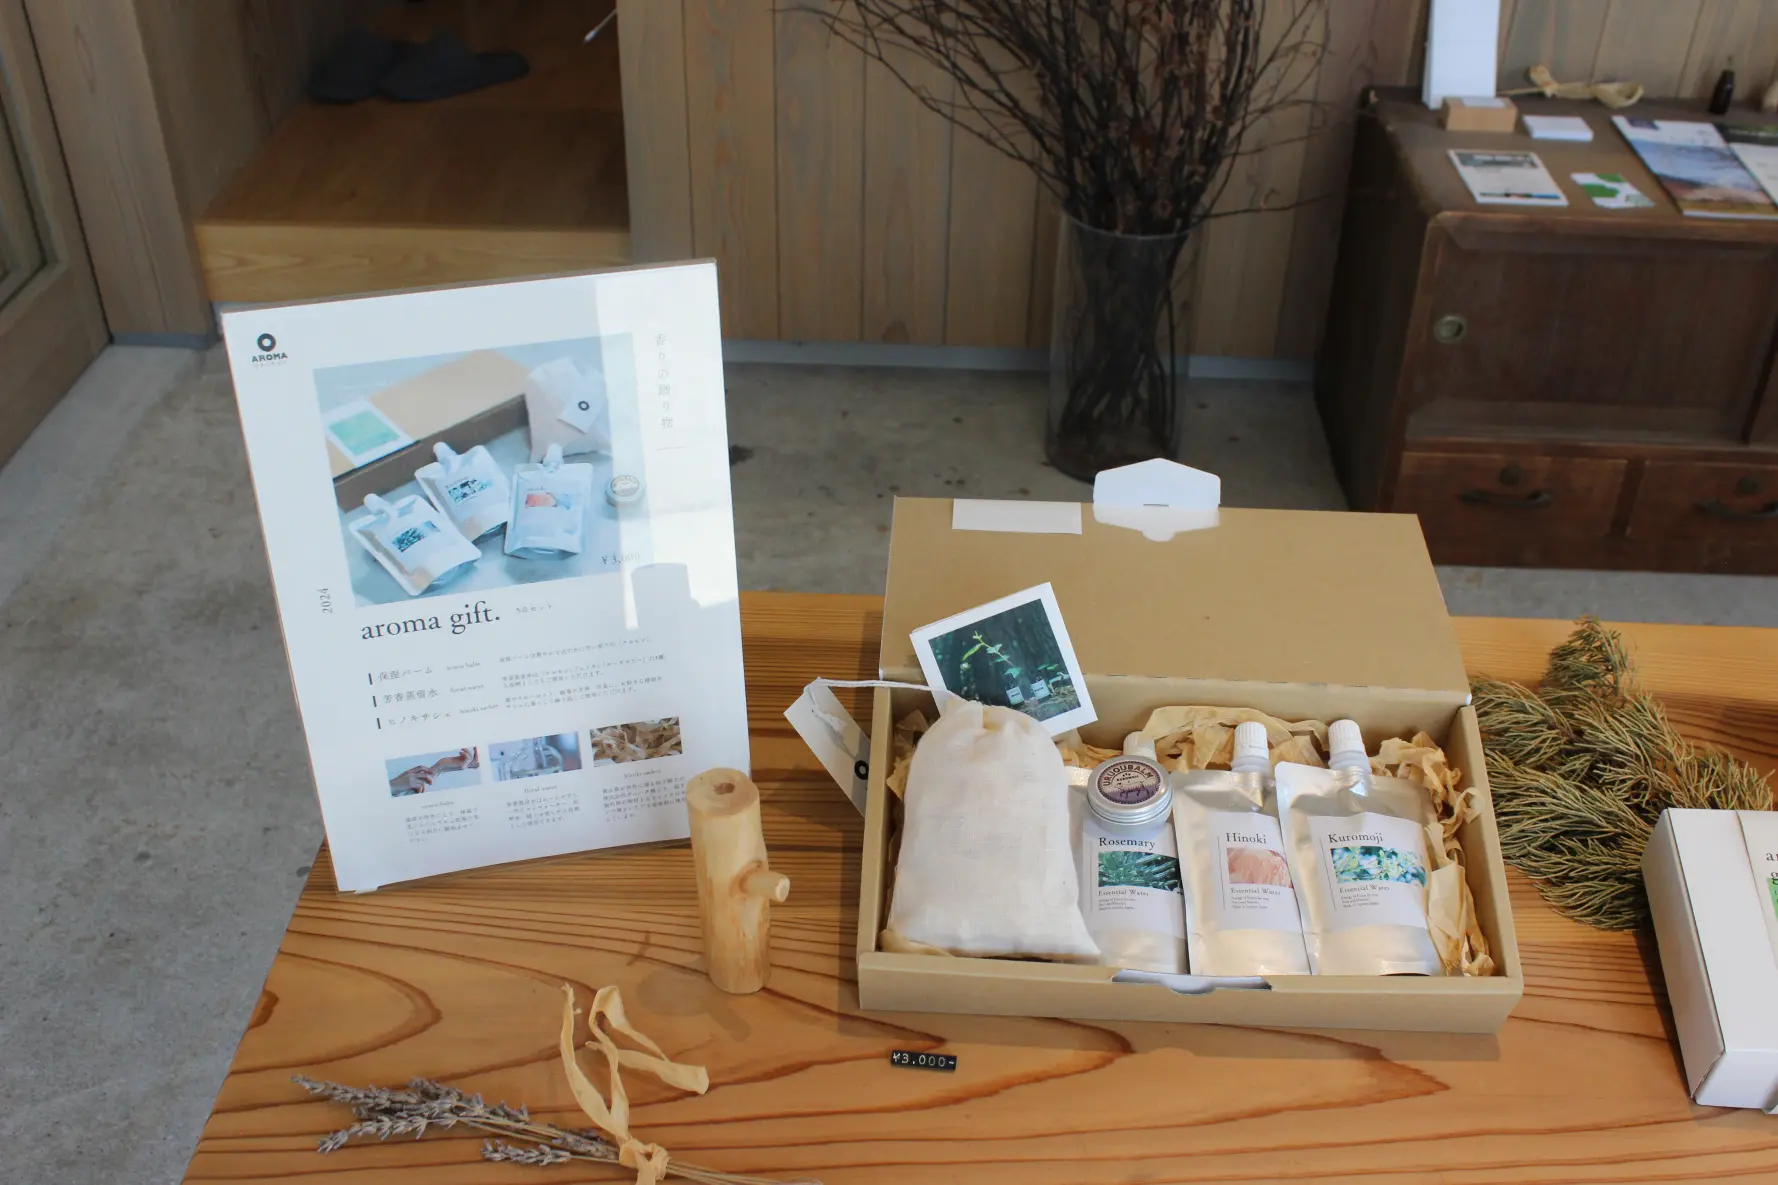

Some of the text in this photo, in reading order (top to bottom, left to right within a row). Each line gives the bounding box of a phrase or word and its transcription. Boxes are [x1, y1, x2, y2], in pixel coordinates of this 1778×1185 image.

[252, 352, 289, 363] AROMA
[317, 588, 333, 614] 2024
[361, 600, 501, 640] aroma gift.
[378, 667, 433, 682] 保湿バーム
[384, 688, 439, 704] 芳香蒸留水
[1098, 836, 1155, 851] Rosemary
[1226, 832, 1267, 844] Hinoki
[1328, 832, 1383, 844] Kuromoji
[1128, 888, 1149, 897] Water
[1261, 888, 1281, 896] Water
[1339, 885, 1368, 894] Essential
